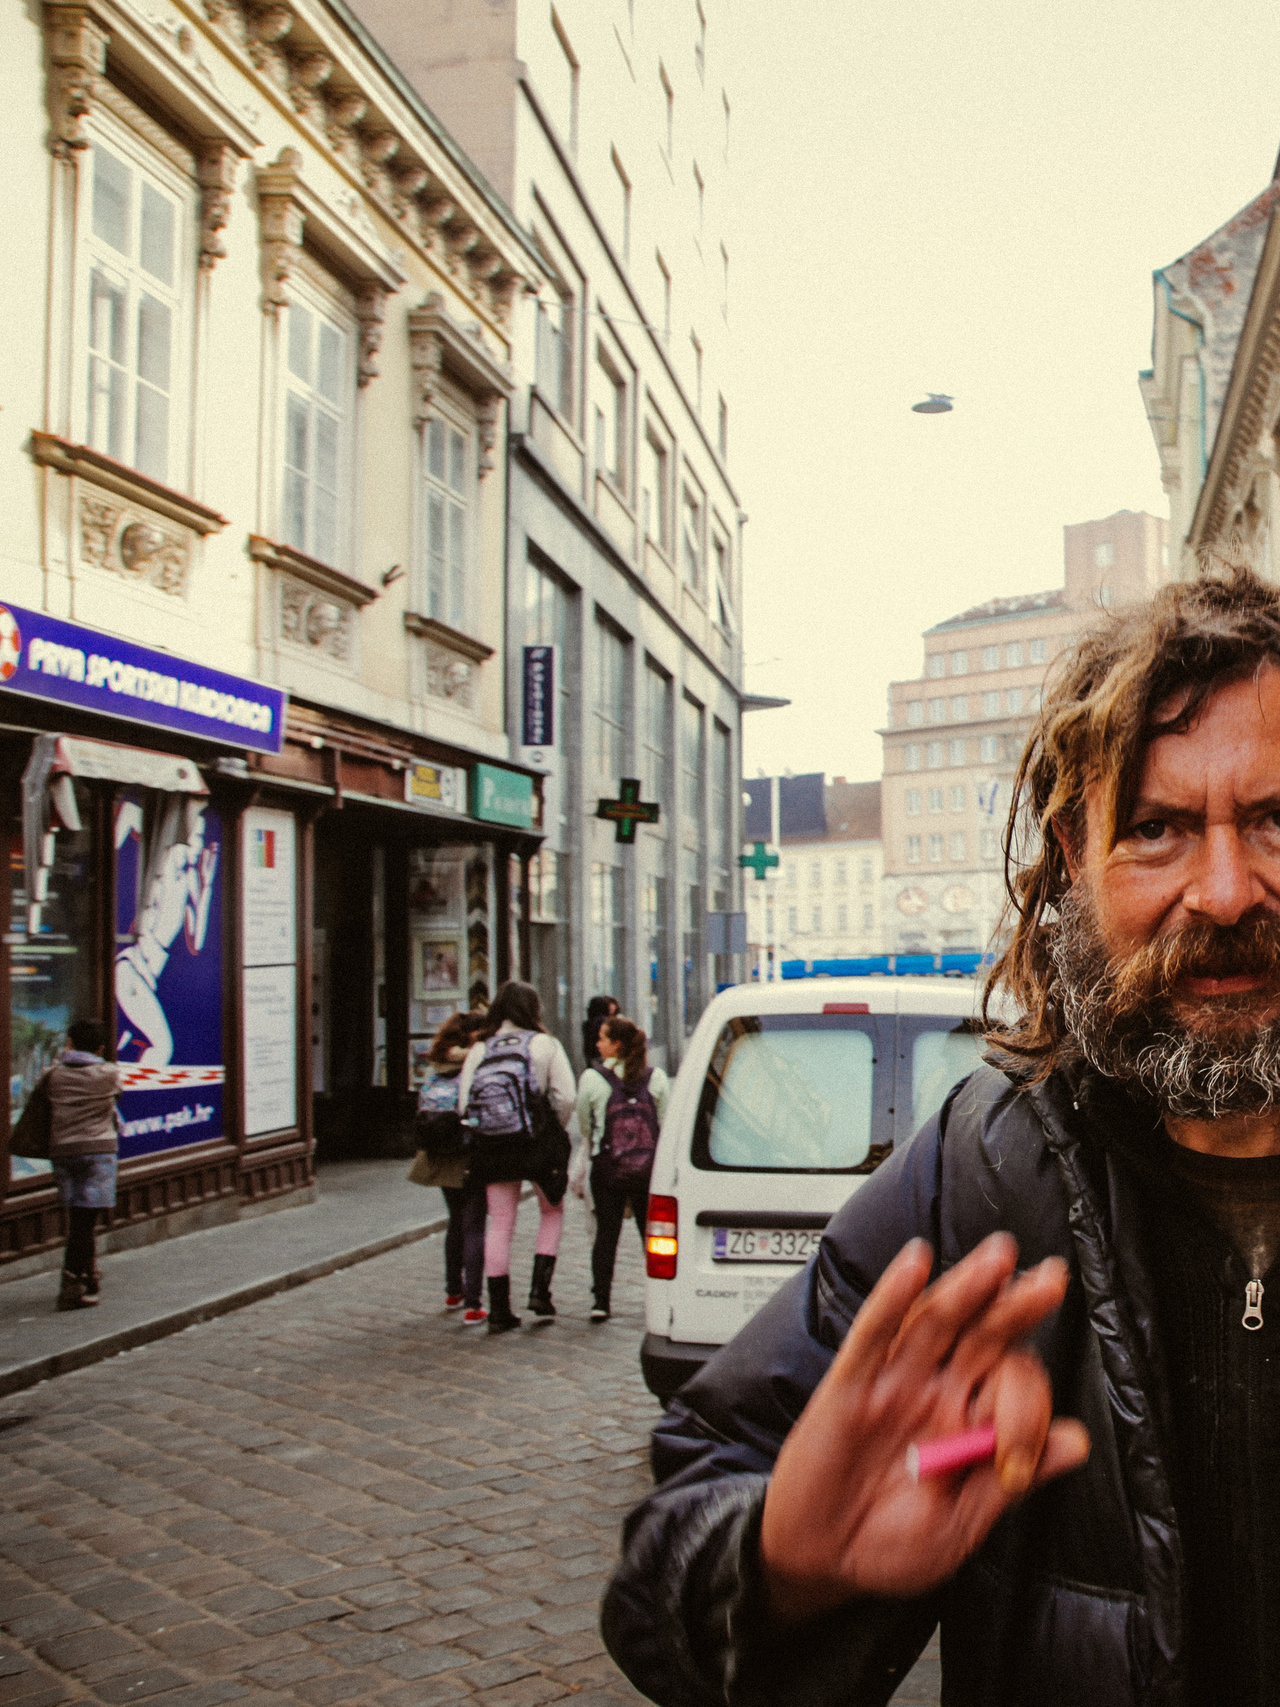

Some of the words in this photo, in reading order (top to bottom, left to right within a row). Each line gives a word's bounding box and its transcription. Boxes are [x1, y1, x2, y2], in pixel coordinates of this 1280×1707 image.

[28, 637, 85, 682] PRVA
[729, 1230, 756, 1255] ZG
[695, 1288, 738, 1298] CADDY
